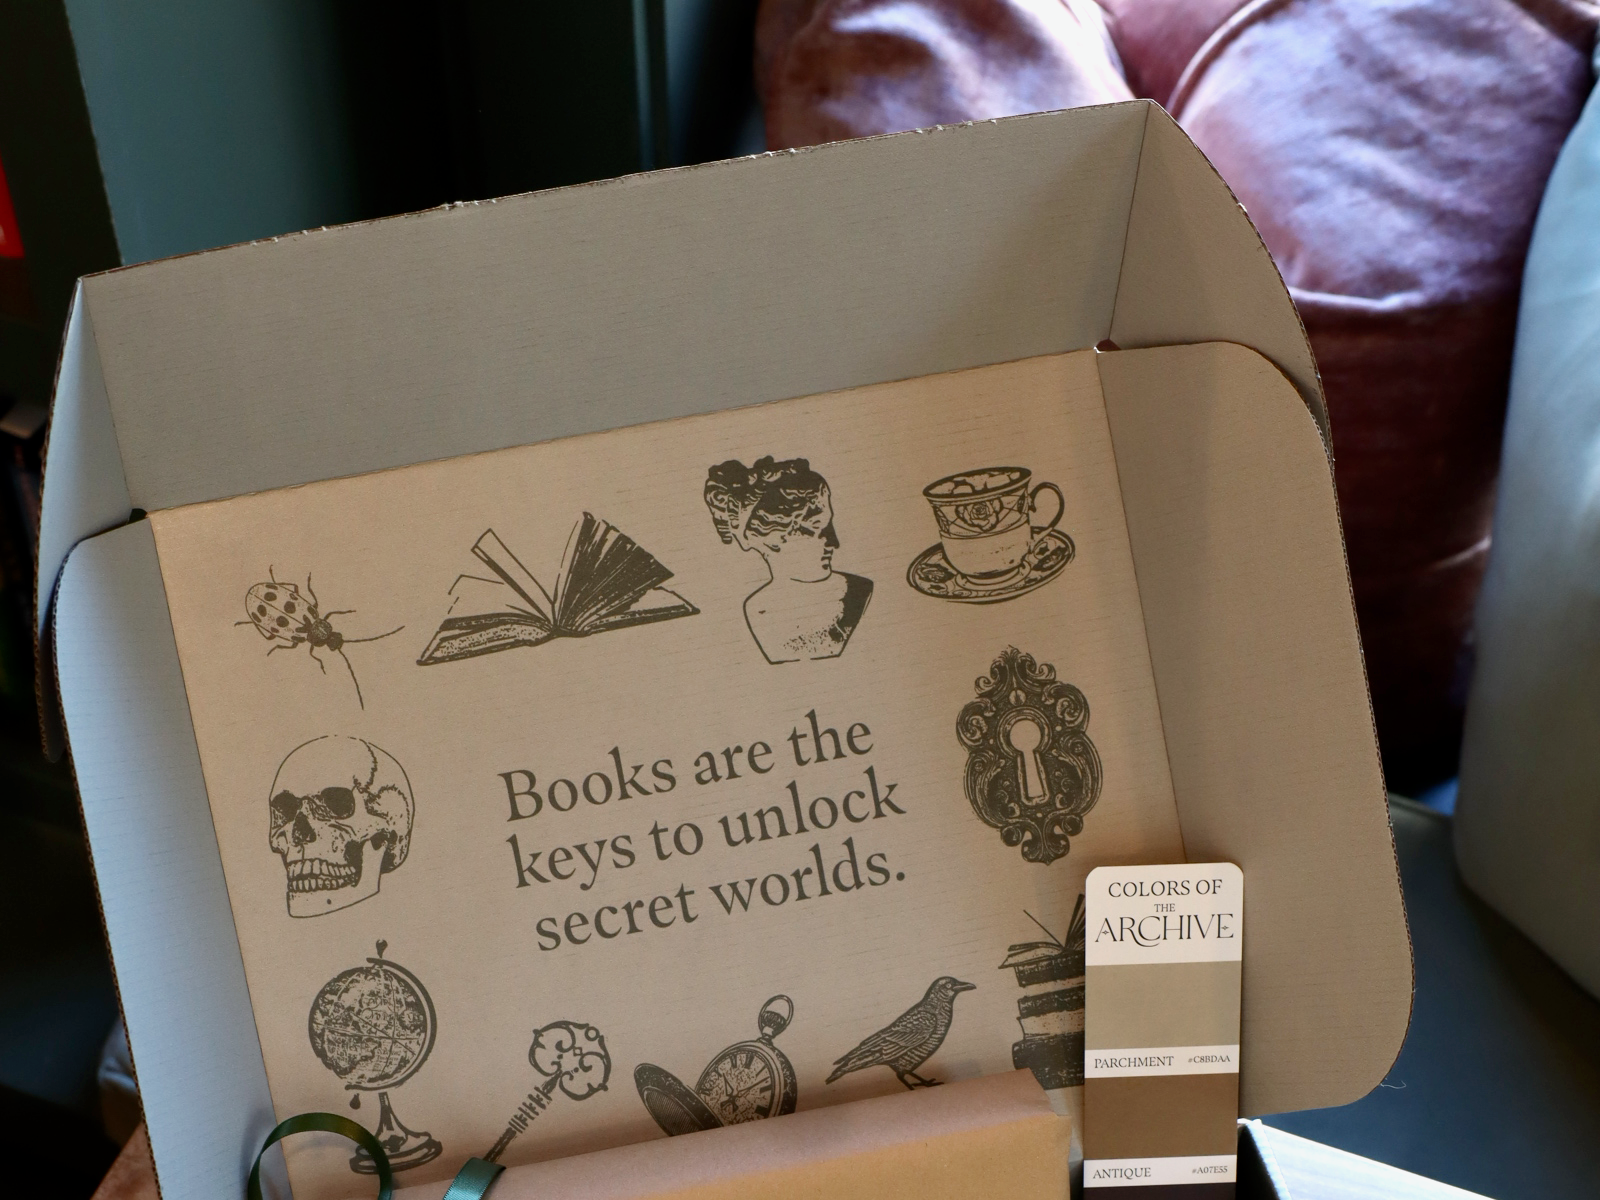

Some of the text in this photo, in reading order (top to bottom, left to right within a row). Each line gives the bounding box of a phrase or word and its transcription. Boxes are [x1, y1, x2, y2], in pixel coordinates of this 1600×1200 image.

[498, 708, 874, 822] Books are the
[505, 765, 907, 891] keys to unlock
[535, 836, 906, 951] secret worlds.
[1108, 879, 1223, 898] COLORS OF
[1153, 903, 1176, 913] THE
[1095, 913, 1234, 948] ARCHIVE
[1094, 1055, 1175, 1069] PARCHMENT
[1092, 1167, 1152, 1180] ANTIQUE
